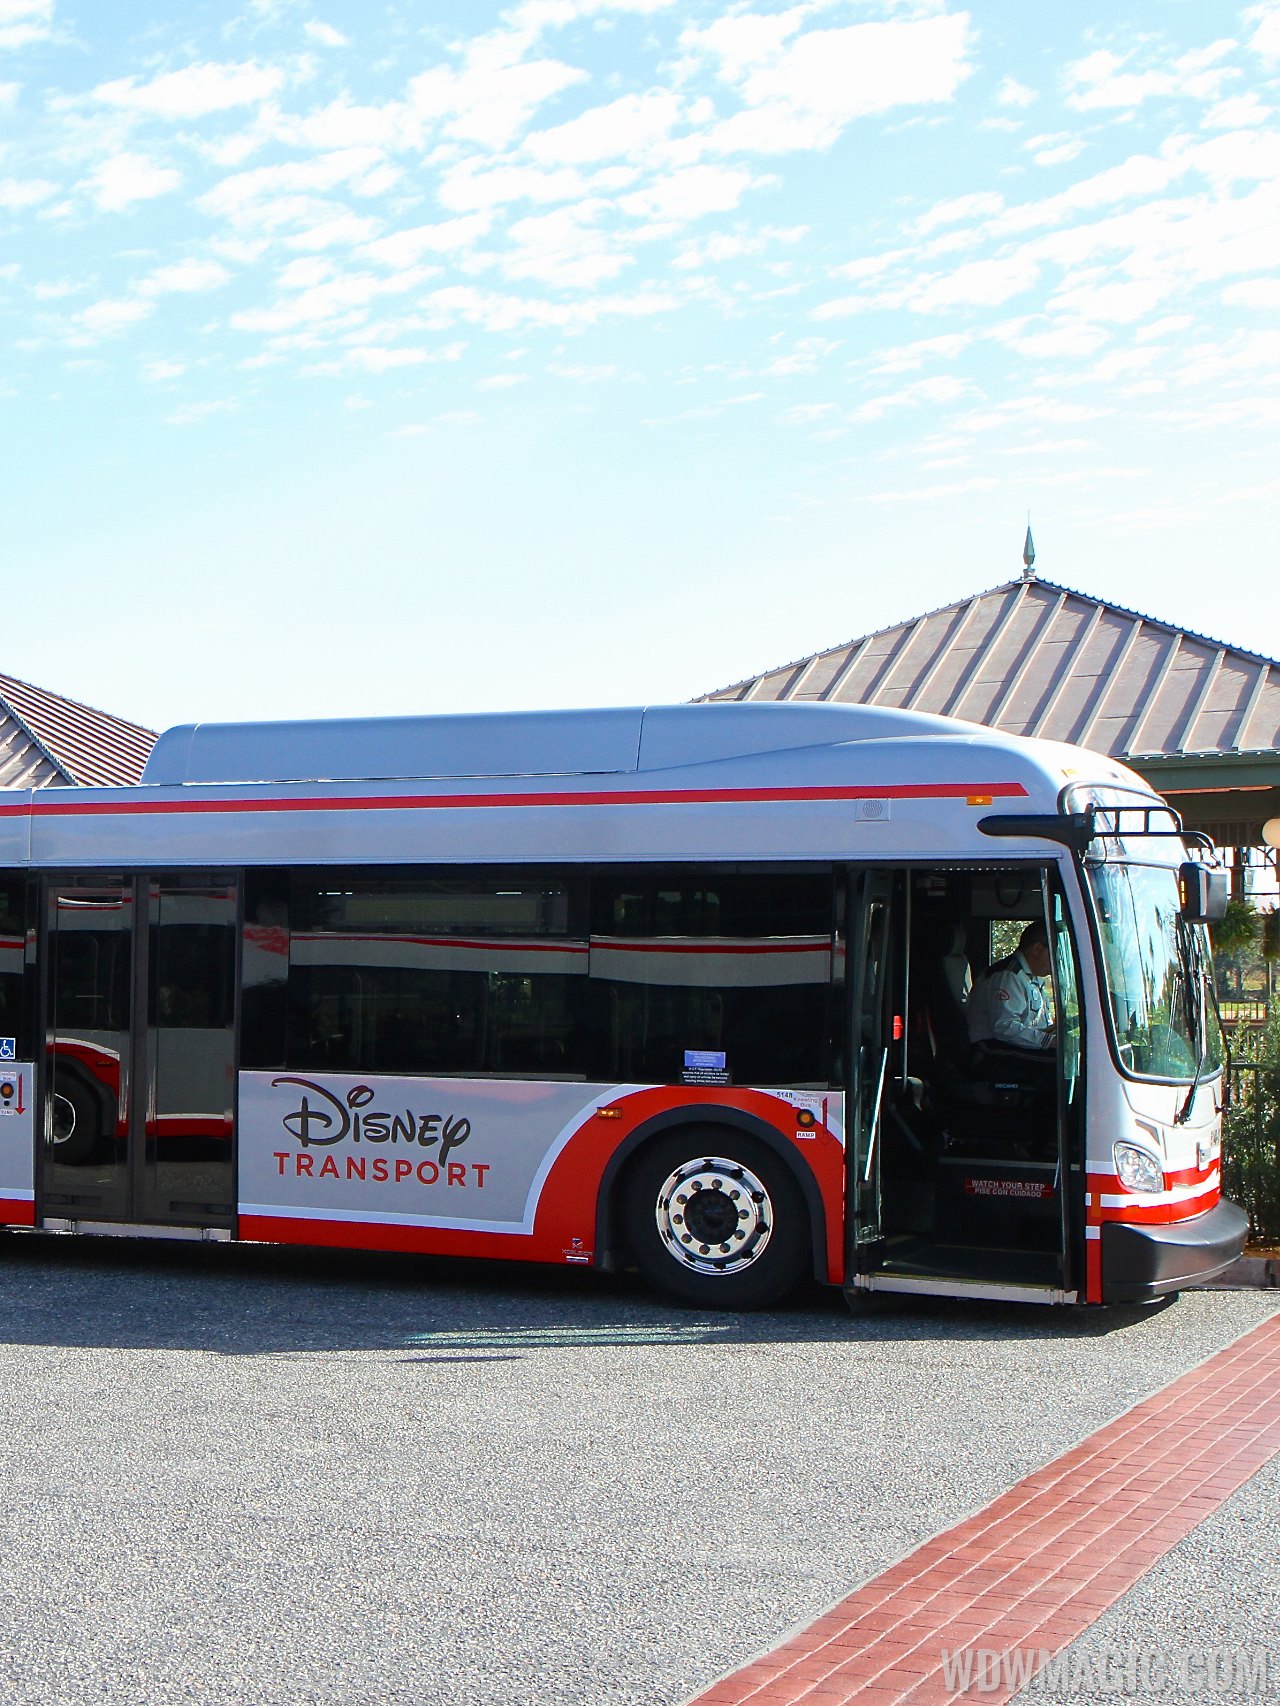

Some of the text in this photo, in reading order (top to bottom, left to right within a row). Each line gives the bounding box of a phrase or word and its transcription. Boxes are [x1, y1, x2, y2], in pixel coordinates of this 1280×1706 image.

[776, 1091, 793, 1099] 5148
[273, 1152, 490, 1188] TRANSPORT
[971, 1179, 1046, 1191] WATCH YOUR STEP
[974, 1187, 1042, 1198] PISE CON CUIDADO
